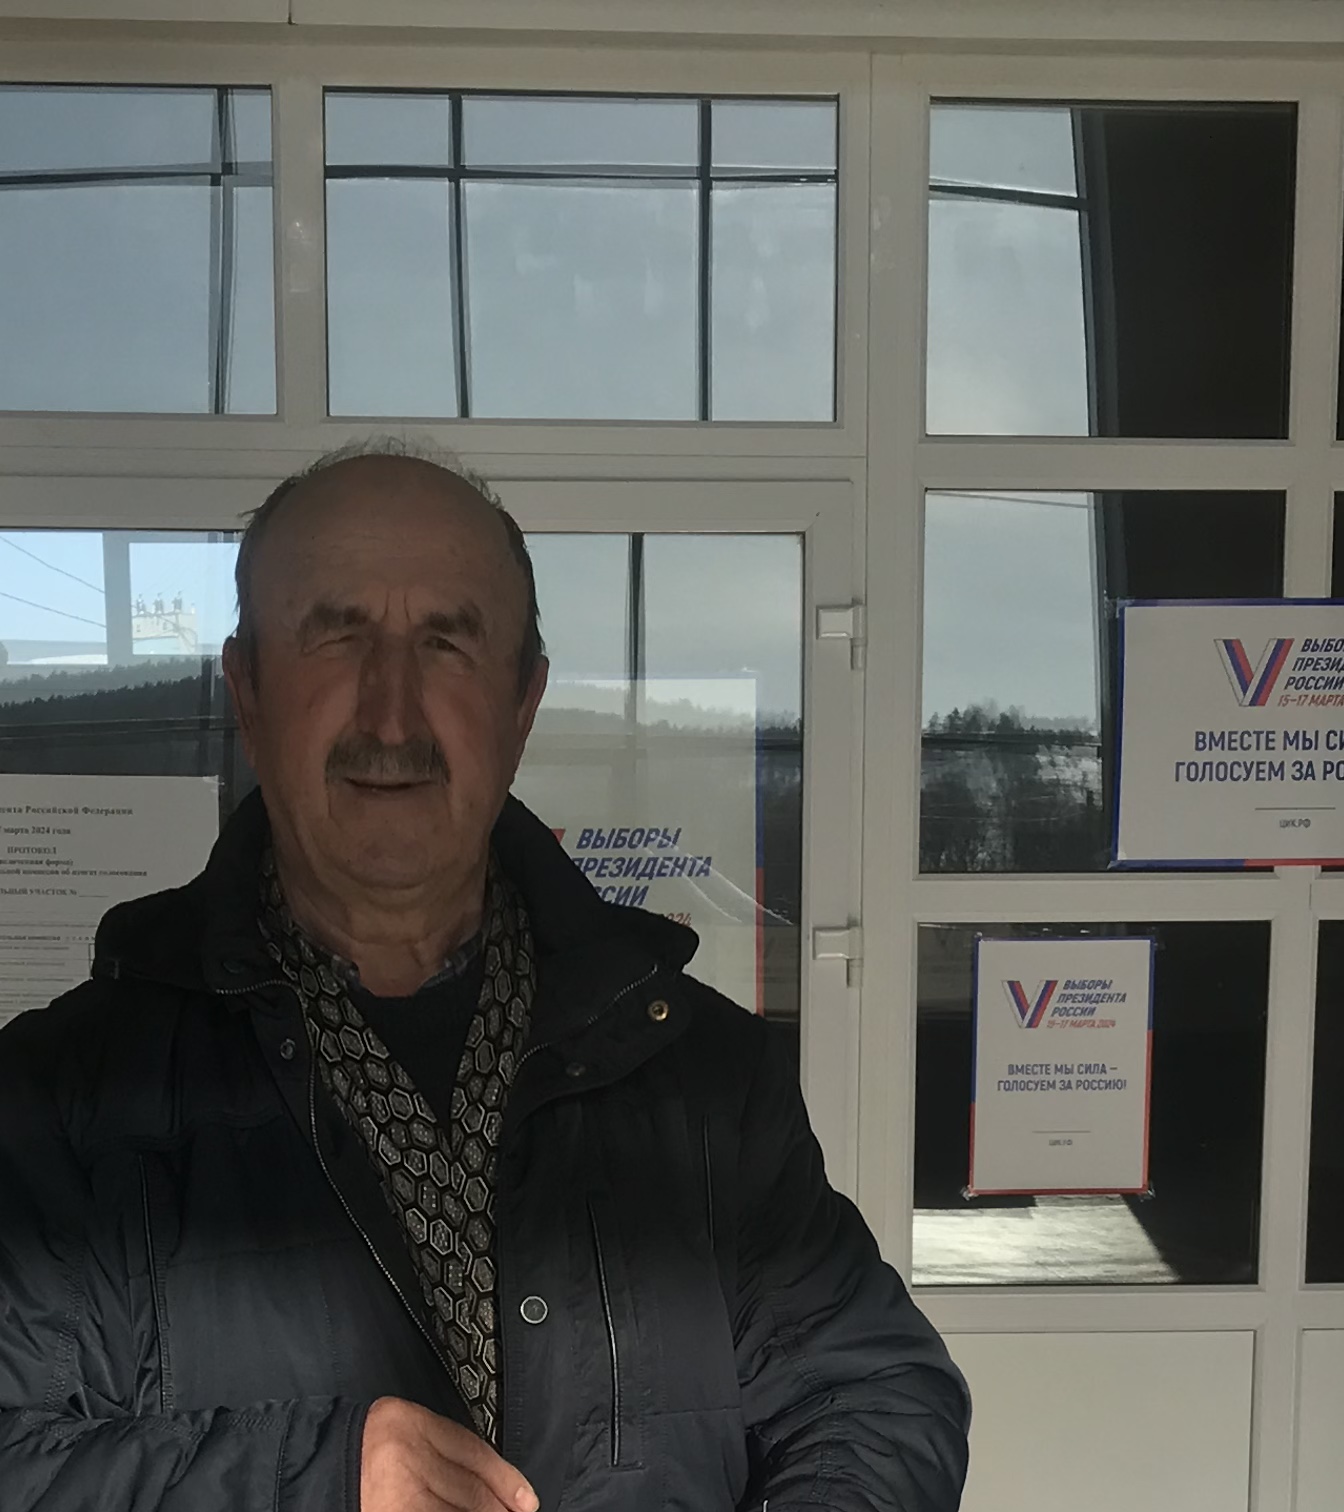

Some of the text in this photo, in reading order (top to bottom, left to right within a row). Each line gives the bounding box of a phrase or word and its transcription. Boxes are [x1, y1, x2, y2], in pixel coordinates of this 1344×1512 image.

[1309, 694, 1344, 706] МАРТА
[1195, 730, 1276, 751] ВМЕСТЕ
[1283, 730, 1319, 751] МЫ
[1175, 760, 1285, 782] ГОЛОСУЕМ
[1291, 760, 1316, 781] ЗА
[576, 827, 682, 849] ВЫБОРЫ
[1062, 979, 1113, 990] ВЫБОРЫ
[1056, 992, 1127, 1005] ПРЕЗИДЕНТА
[1050, 1006, 1096, 1017] РОССИИ
[1007, 1063, 1051, 1075] ВМЕСТЕ
[1054, 1063, 1074, 1075] МЫ
[1077, 1063, 1107, 1075] СИЛА
[997, 1078, 1127, 1091] ГОЛОСУЕМ ЗА РОССИЮ!
